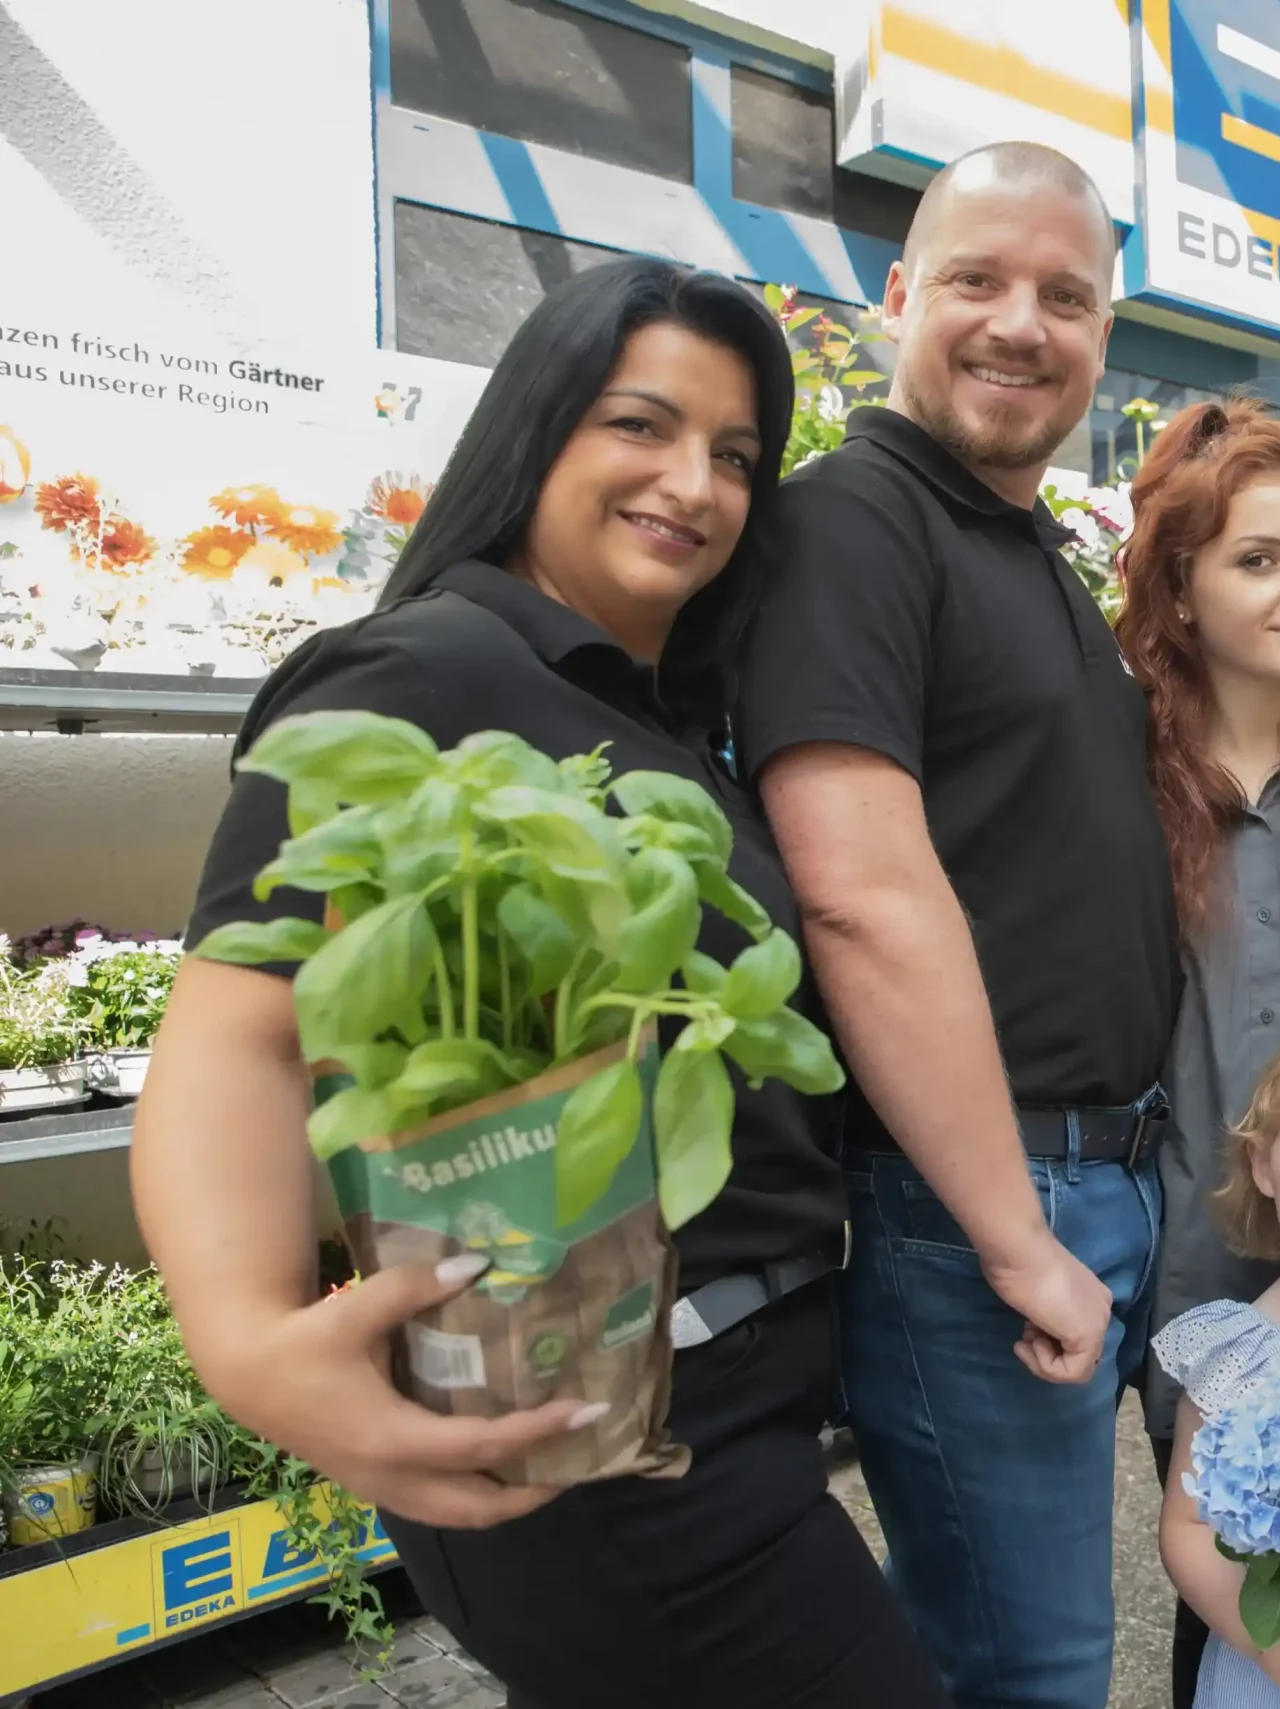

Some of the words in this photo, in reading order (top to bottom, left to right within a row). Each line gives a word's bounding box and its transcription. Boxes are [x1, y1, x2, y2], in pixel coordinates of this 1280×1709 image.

[0, 326, 59, 350] zen
[71, 332, 149, 364] frisch
[160, 353, 218, 375] vom
[228, 360, 325, 392] Gärtner
[0, 360, 48, 382] aus
[59, 370, 168, 399] unserer
[178, 383, 269, 413] Region
[402, 1120, 563, 1193] Basiliku
[165, 1594, 236, 1629] EDEKA
